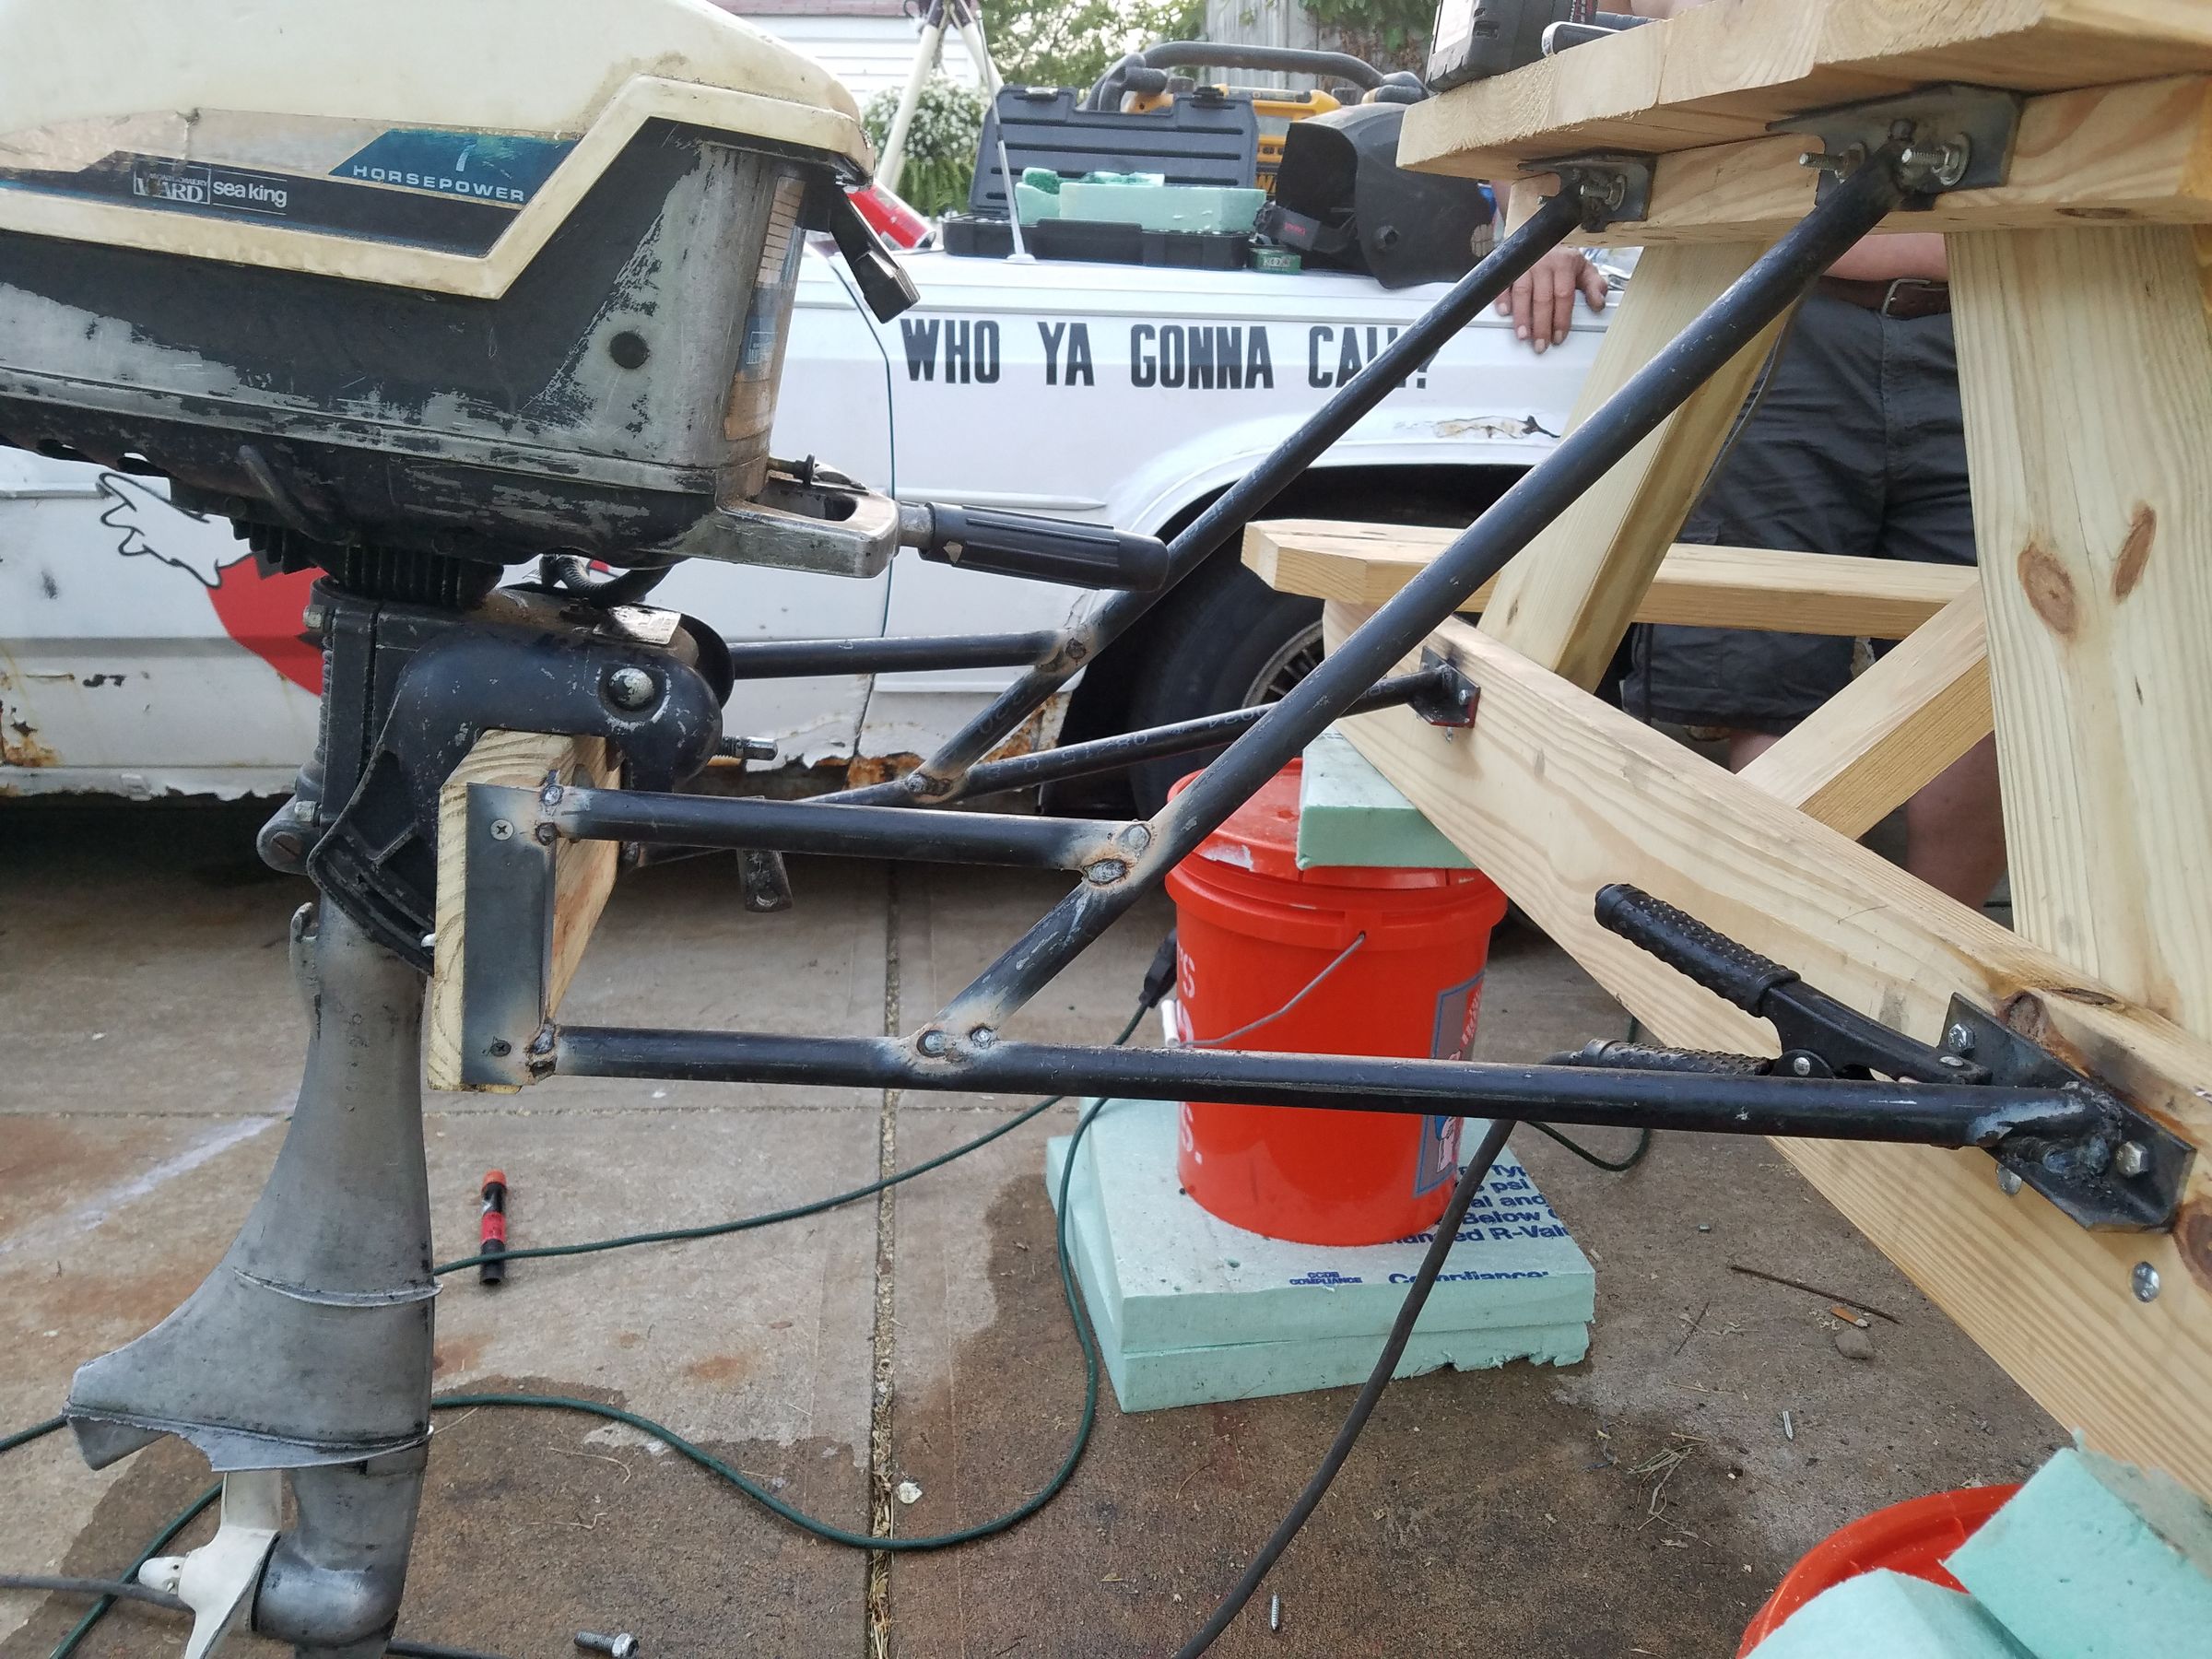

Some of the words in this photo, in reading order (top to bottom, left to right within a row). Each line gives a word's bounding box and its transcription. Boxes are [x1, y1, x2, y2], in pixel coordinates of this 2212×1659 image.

[213, 181, 245, 198] sea
[248, 183, 288, 208] king
[353, 164, 524, 202] HORSEPOWER
[900, 318, 1002, 384] WHO
[1037, 322, 1095, 387] YA
[1130, 324, 1274, 390] GONNA
[1489, 1179, 1531, 1194] psi
[1289, 1277, 1363, 1286] COMPLIANCE
